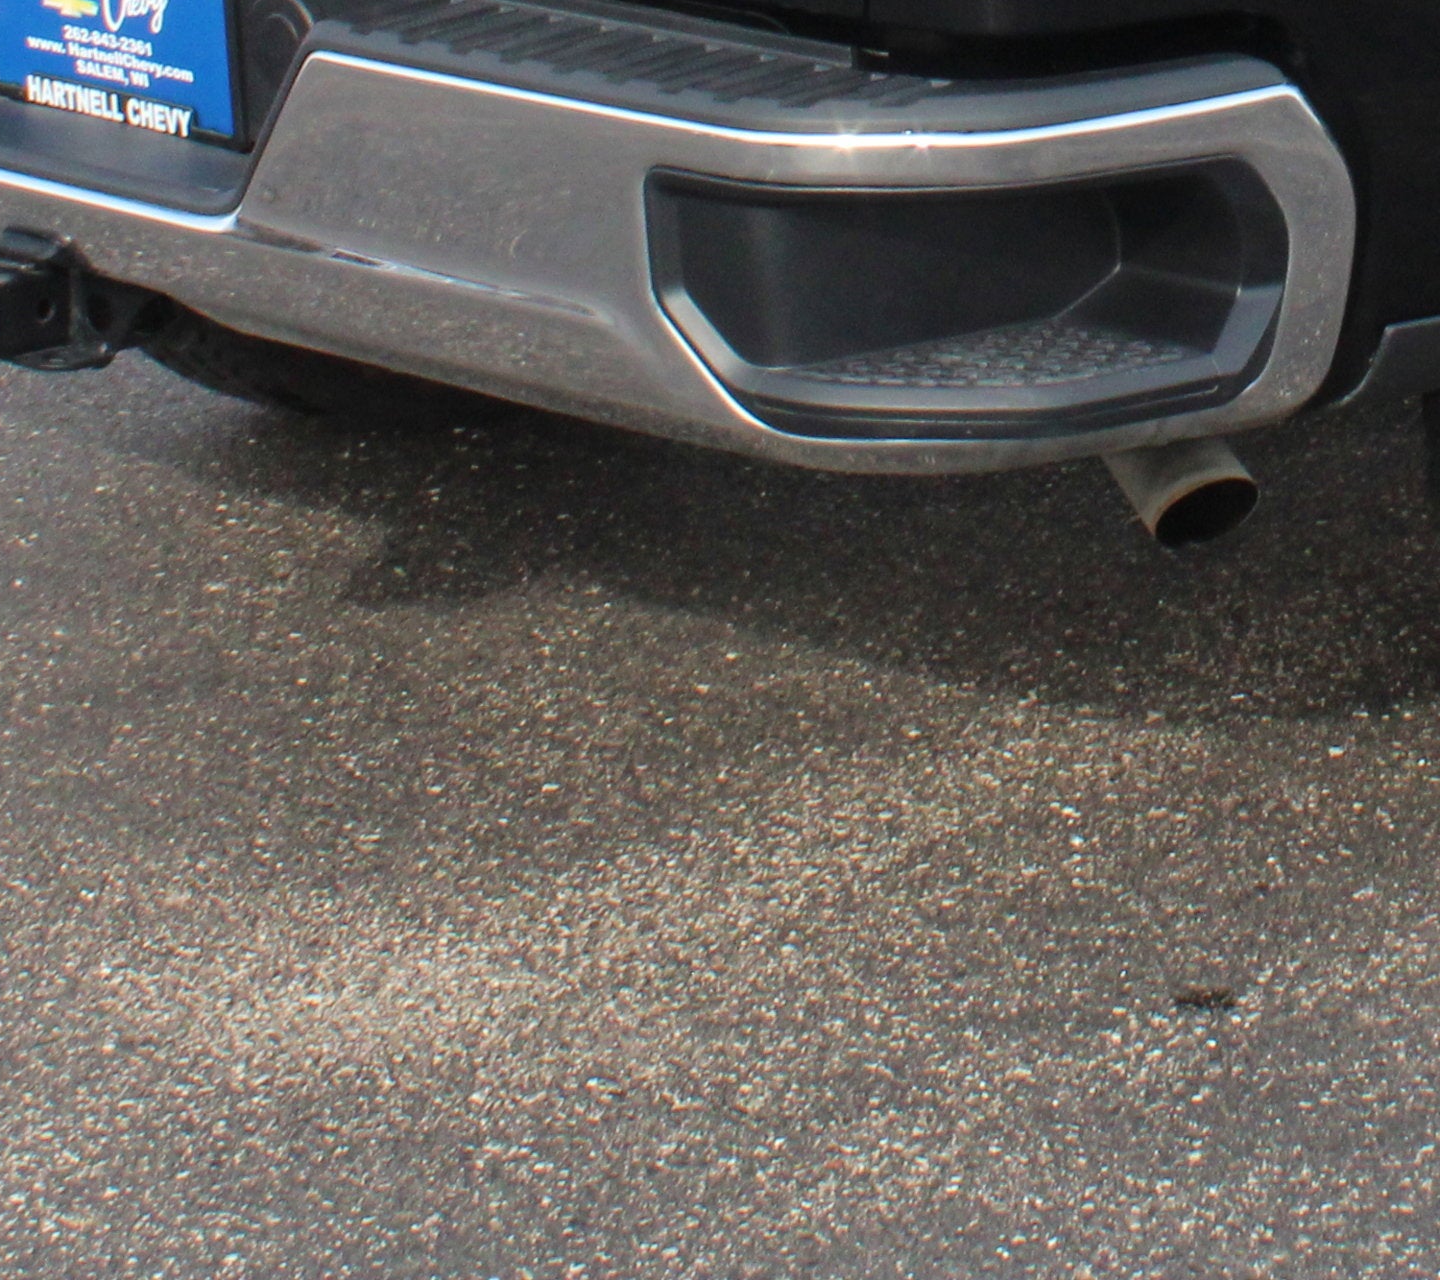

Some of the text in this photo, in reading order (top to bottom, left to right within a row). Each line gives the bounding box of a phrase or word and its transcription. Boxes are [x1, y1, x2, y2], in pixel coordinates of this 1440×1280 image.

[67, 42, 193, 82] HartnellChevy.com
[75, 60, 149, 88] SALEM, WI
[26, 74, 191, 138] HARTNELL CHEVY
